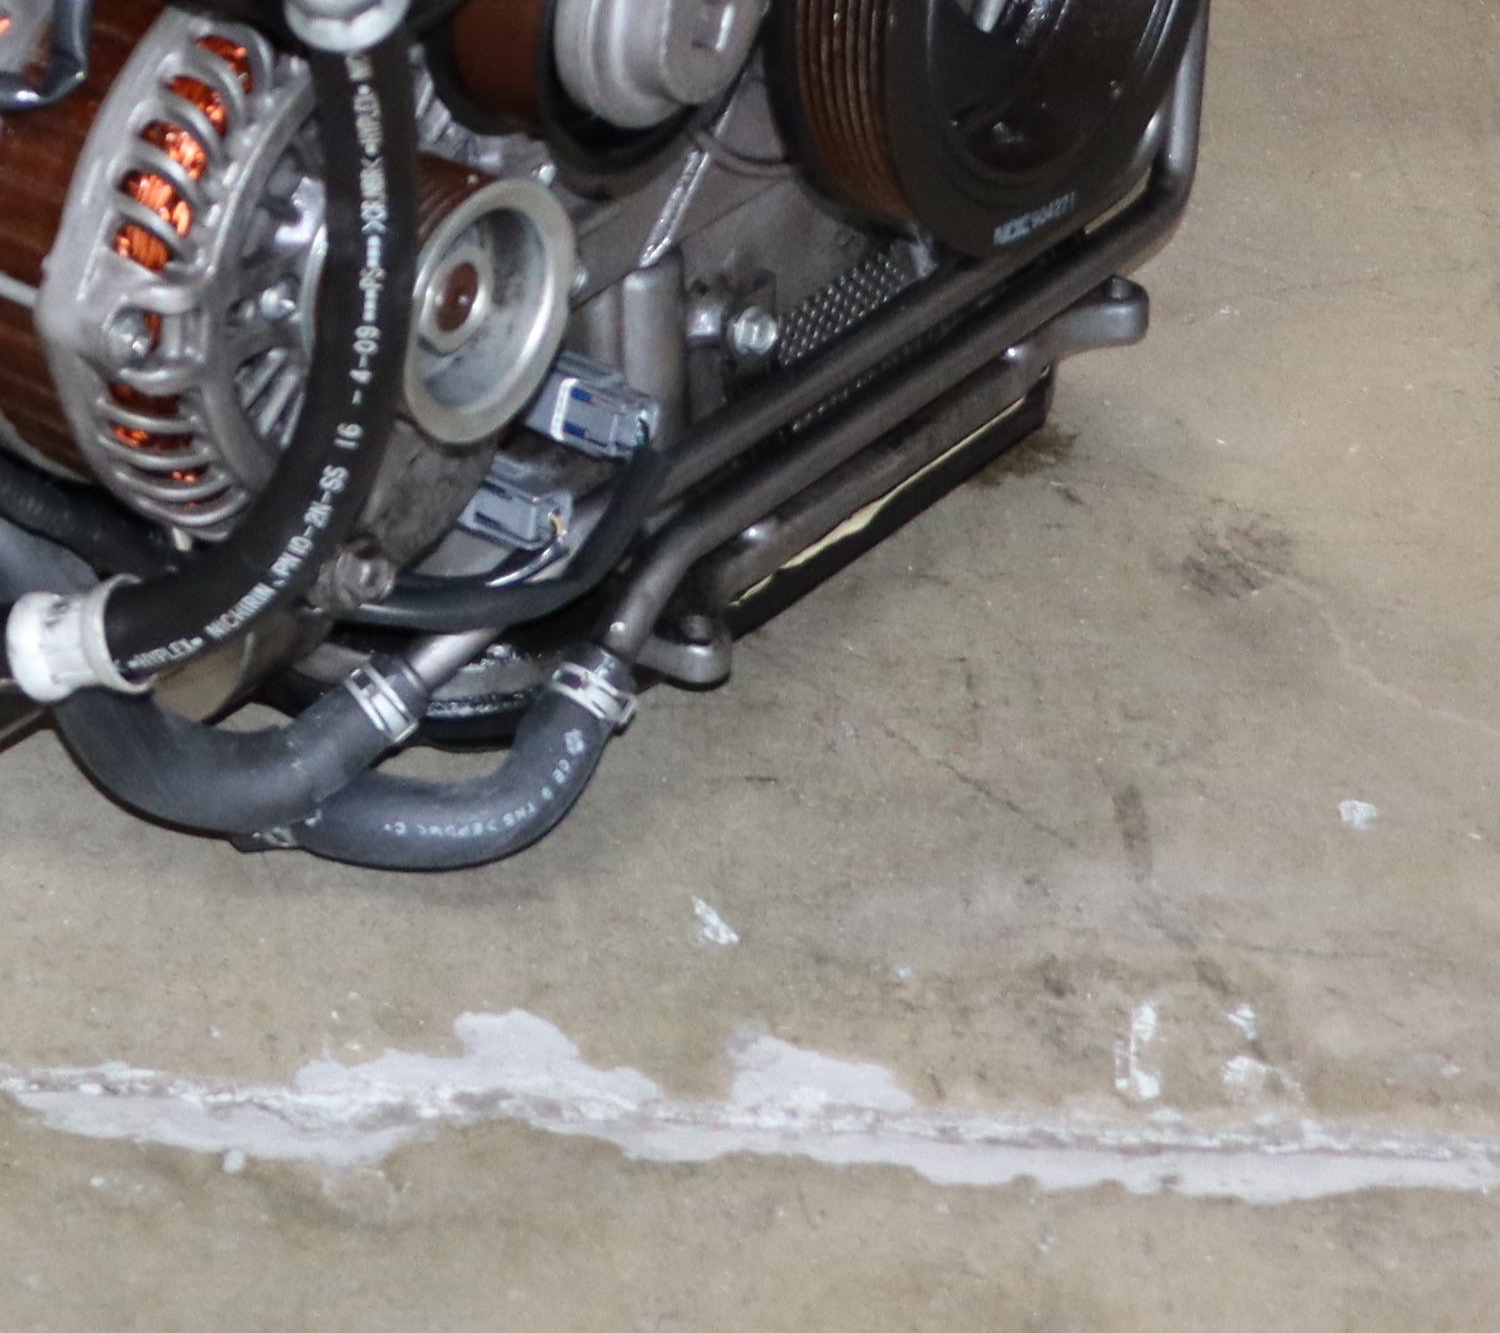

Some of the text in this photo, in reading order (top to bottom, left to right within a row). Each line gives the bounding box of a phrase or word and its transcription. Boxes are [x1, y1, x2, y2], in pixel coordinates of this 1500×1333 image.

[203, 582, 277, 639] NICHIRIN
[333, 422, 364, 450] 16
[349, 325, 381, 384] 4-09
